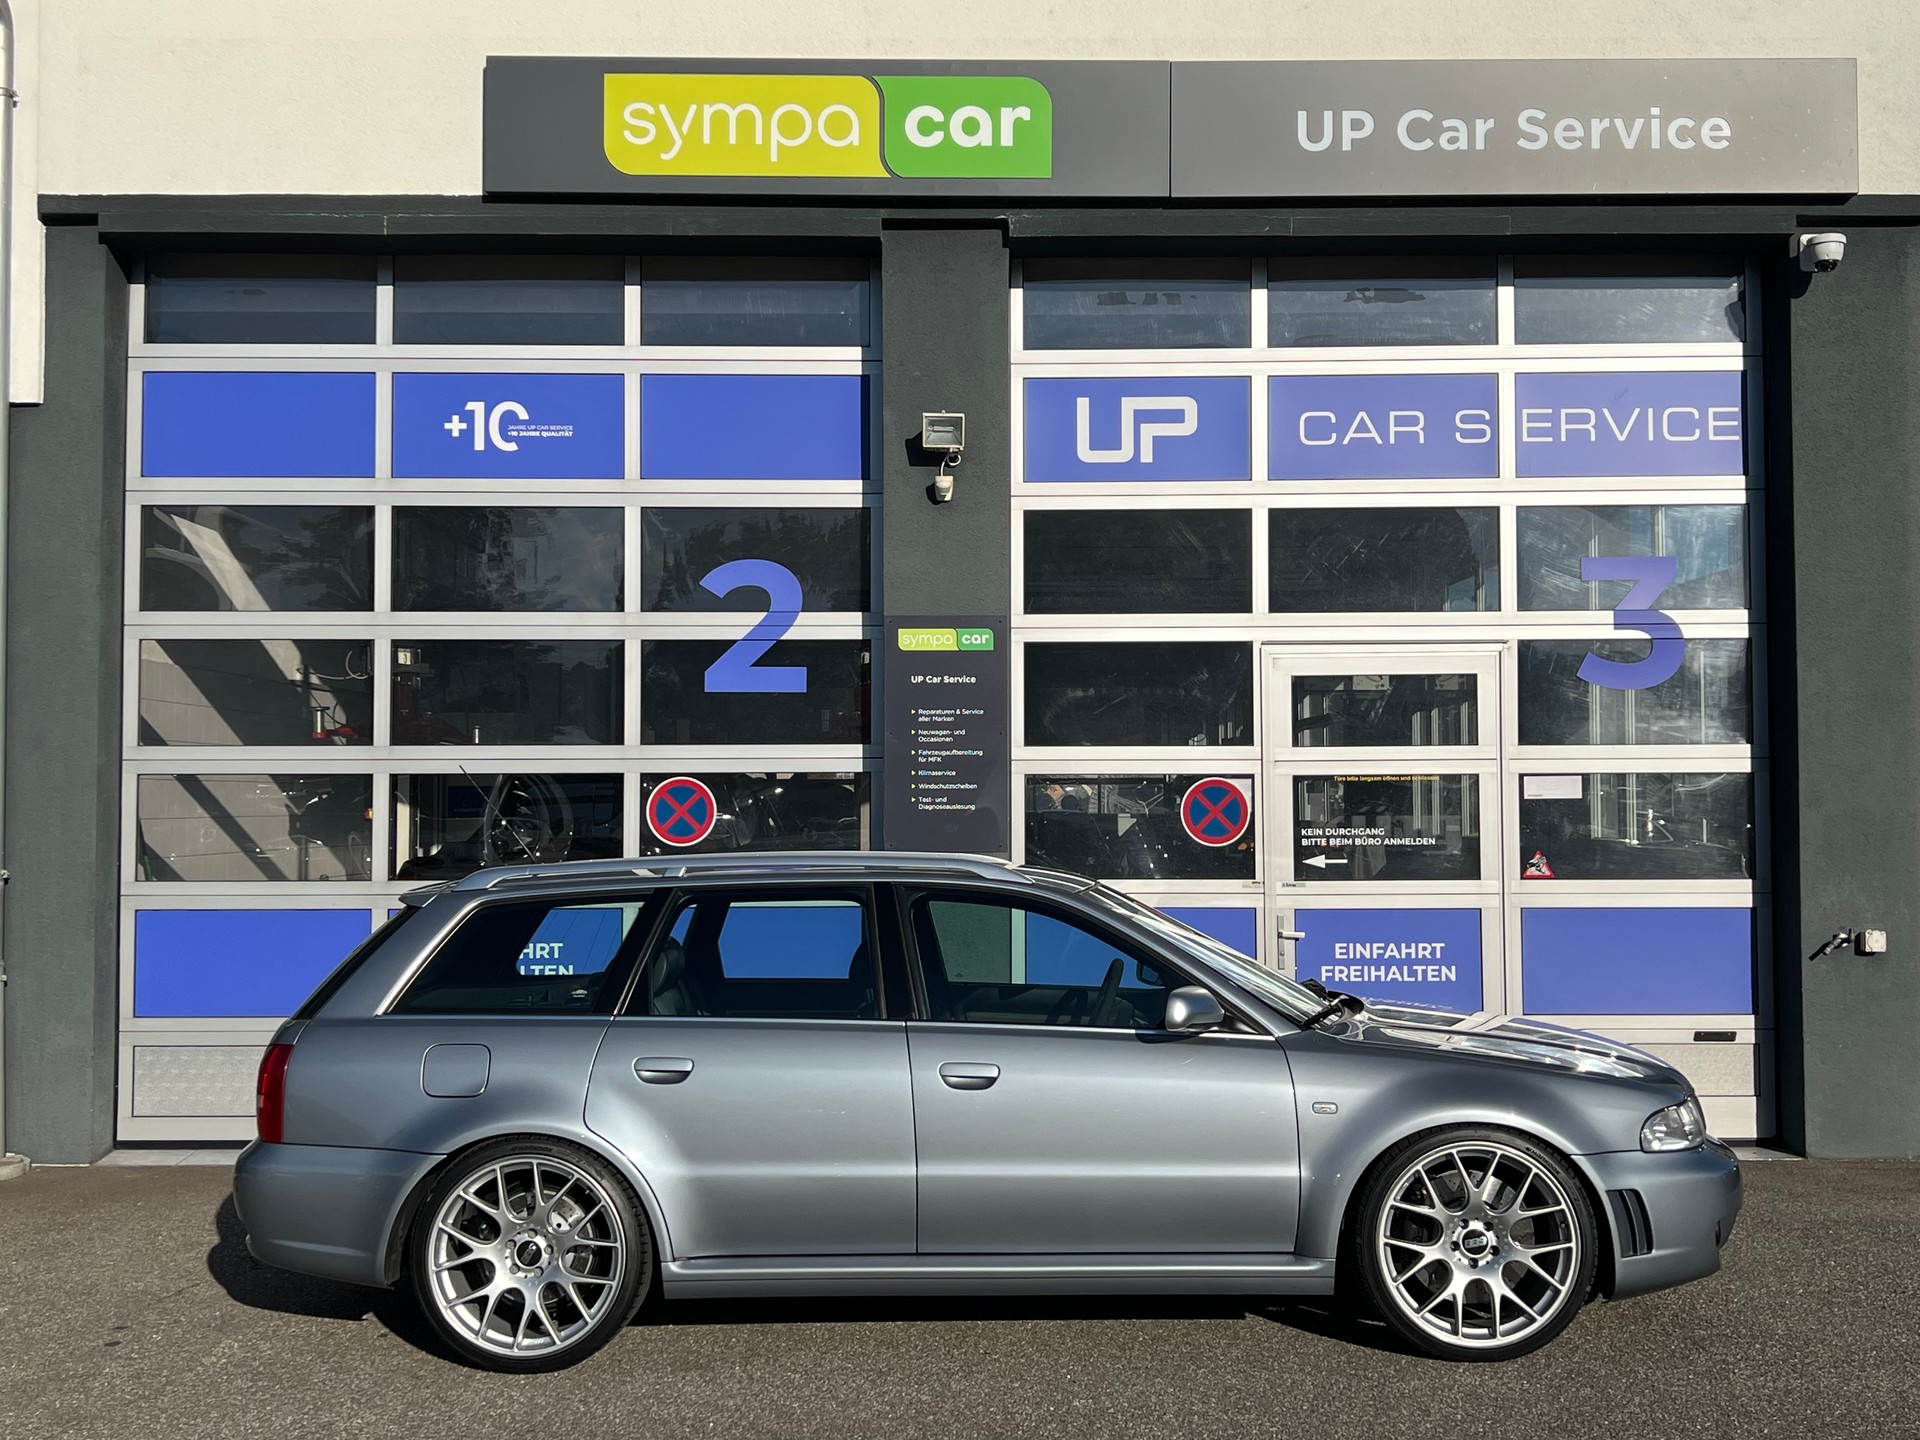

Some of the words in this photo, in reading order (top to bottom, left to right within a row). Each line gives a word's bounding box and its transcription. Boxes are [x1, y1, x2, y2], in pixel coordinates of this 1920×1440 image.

[622, 101, 859, 161] sympa
[904, 104, 1031, 147] car
[1297, 110, 1374, 151] UP
[1397, 109, 1495, 150] Car
[1516, 107, 1732, 149] Service
[541, 429, 573, 438] QUALITÄT
[1076, 396, 1198, 463] UP
[1300, 409, 1424, 446] CAR
[1454, 406, 1741, 445] SERVICE
[699, 558, 808, 693] 2
[1575, 556, 1686, 690] 3
[902, 634, 953, 648] sympa
[962, 634, 990, 645] car
[911, 675, 924, 683] UP
[926, 675, 942, 683] Car
[943, 674, 977, 683] Service
[918, 708, 955, 716] Reparaturen
[918, 749, 983, 757] Fahrzeugaufbereitung
[1360, 775, 1382, 783] langsam
[918, 803, 976, 811] Diagnoseauslesung
[1301, 828, 1323, 836] KEIN
[1325, 827, 1385, 836] DURCHGANG
[1302, 838, 1328, 846] BITTE
[1329, 838, 1353, 846] BEIM
[1355, 836, 1381, 846] BÜRO
[1383, 837, 1436, 846] ANMELDEN
[1334, 942, 1445, 959] EINFAHRT
[1320, 965, 1456, 982] FREIHALTEN
